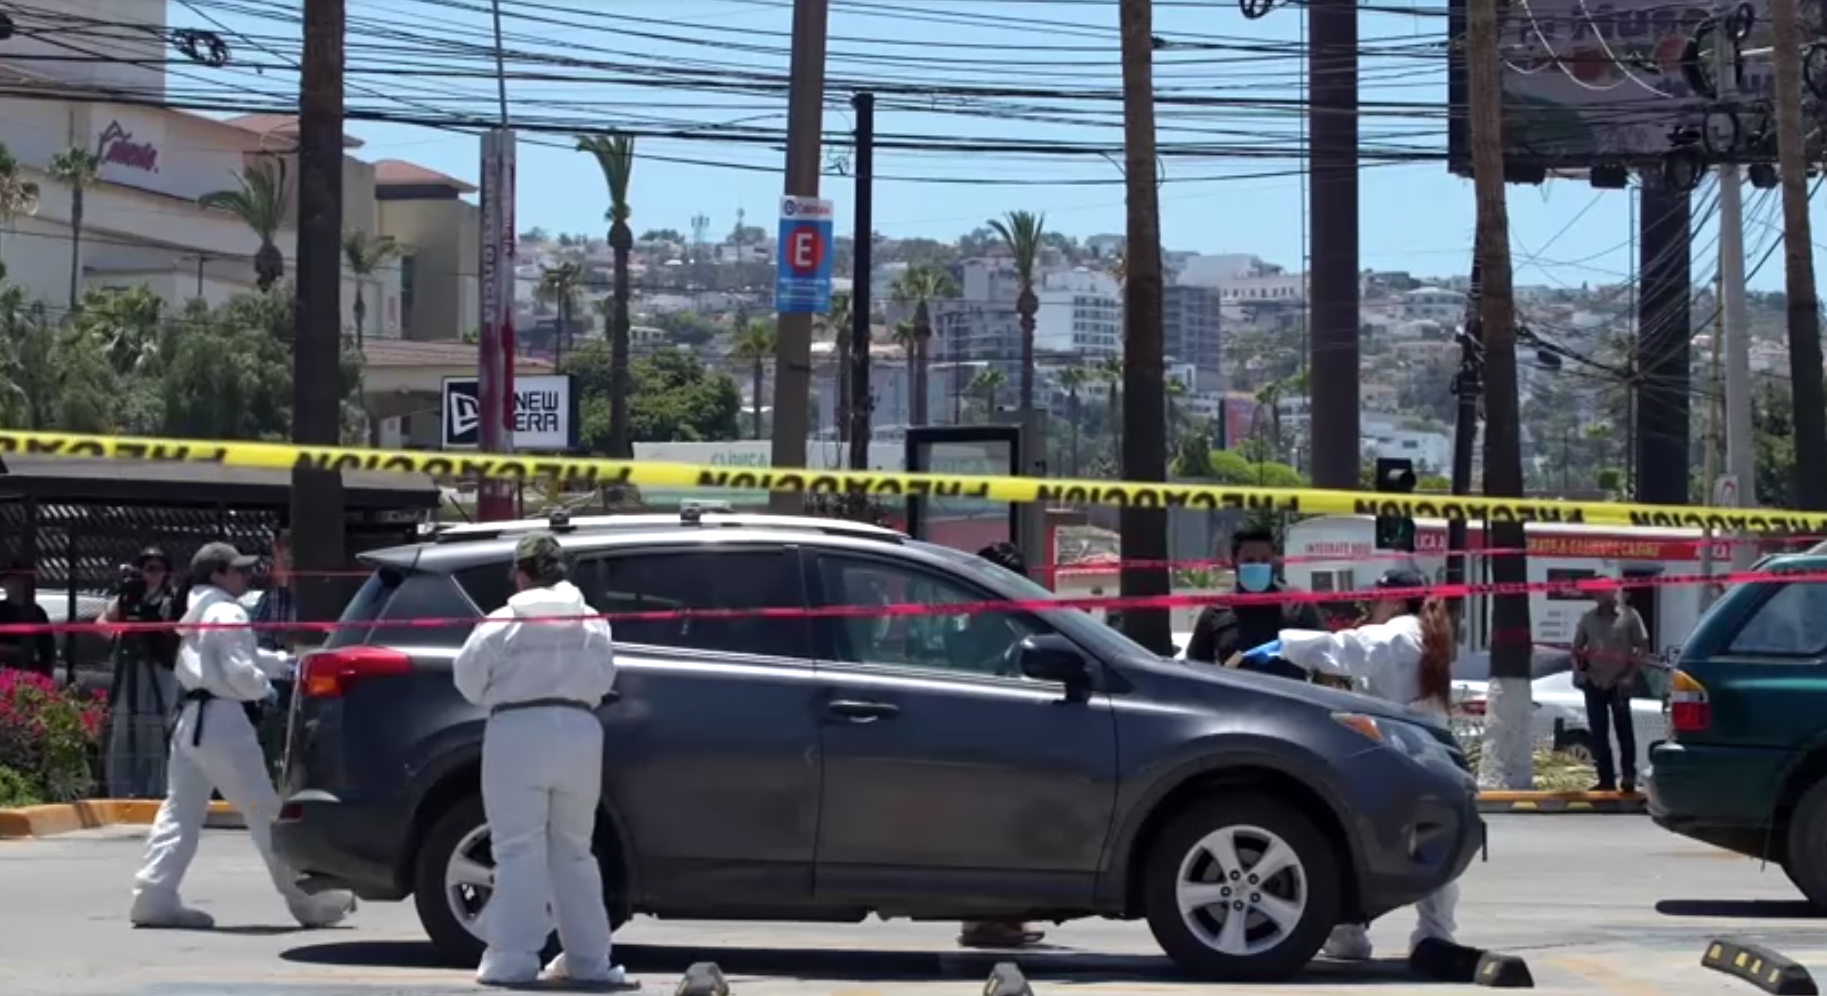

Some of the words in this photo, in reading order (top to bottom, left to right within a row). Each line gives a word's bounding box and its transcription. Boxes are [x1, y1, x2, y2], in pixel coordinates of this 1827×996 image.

[794, 232, 813, 266] E
[513, 391, 559, 411] NEW
[514, 413, 559, 432] ERA
